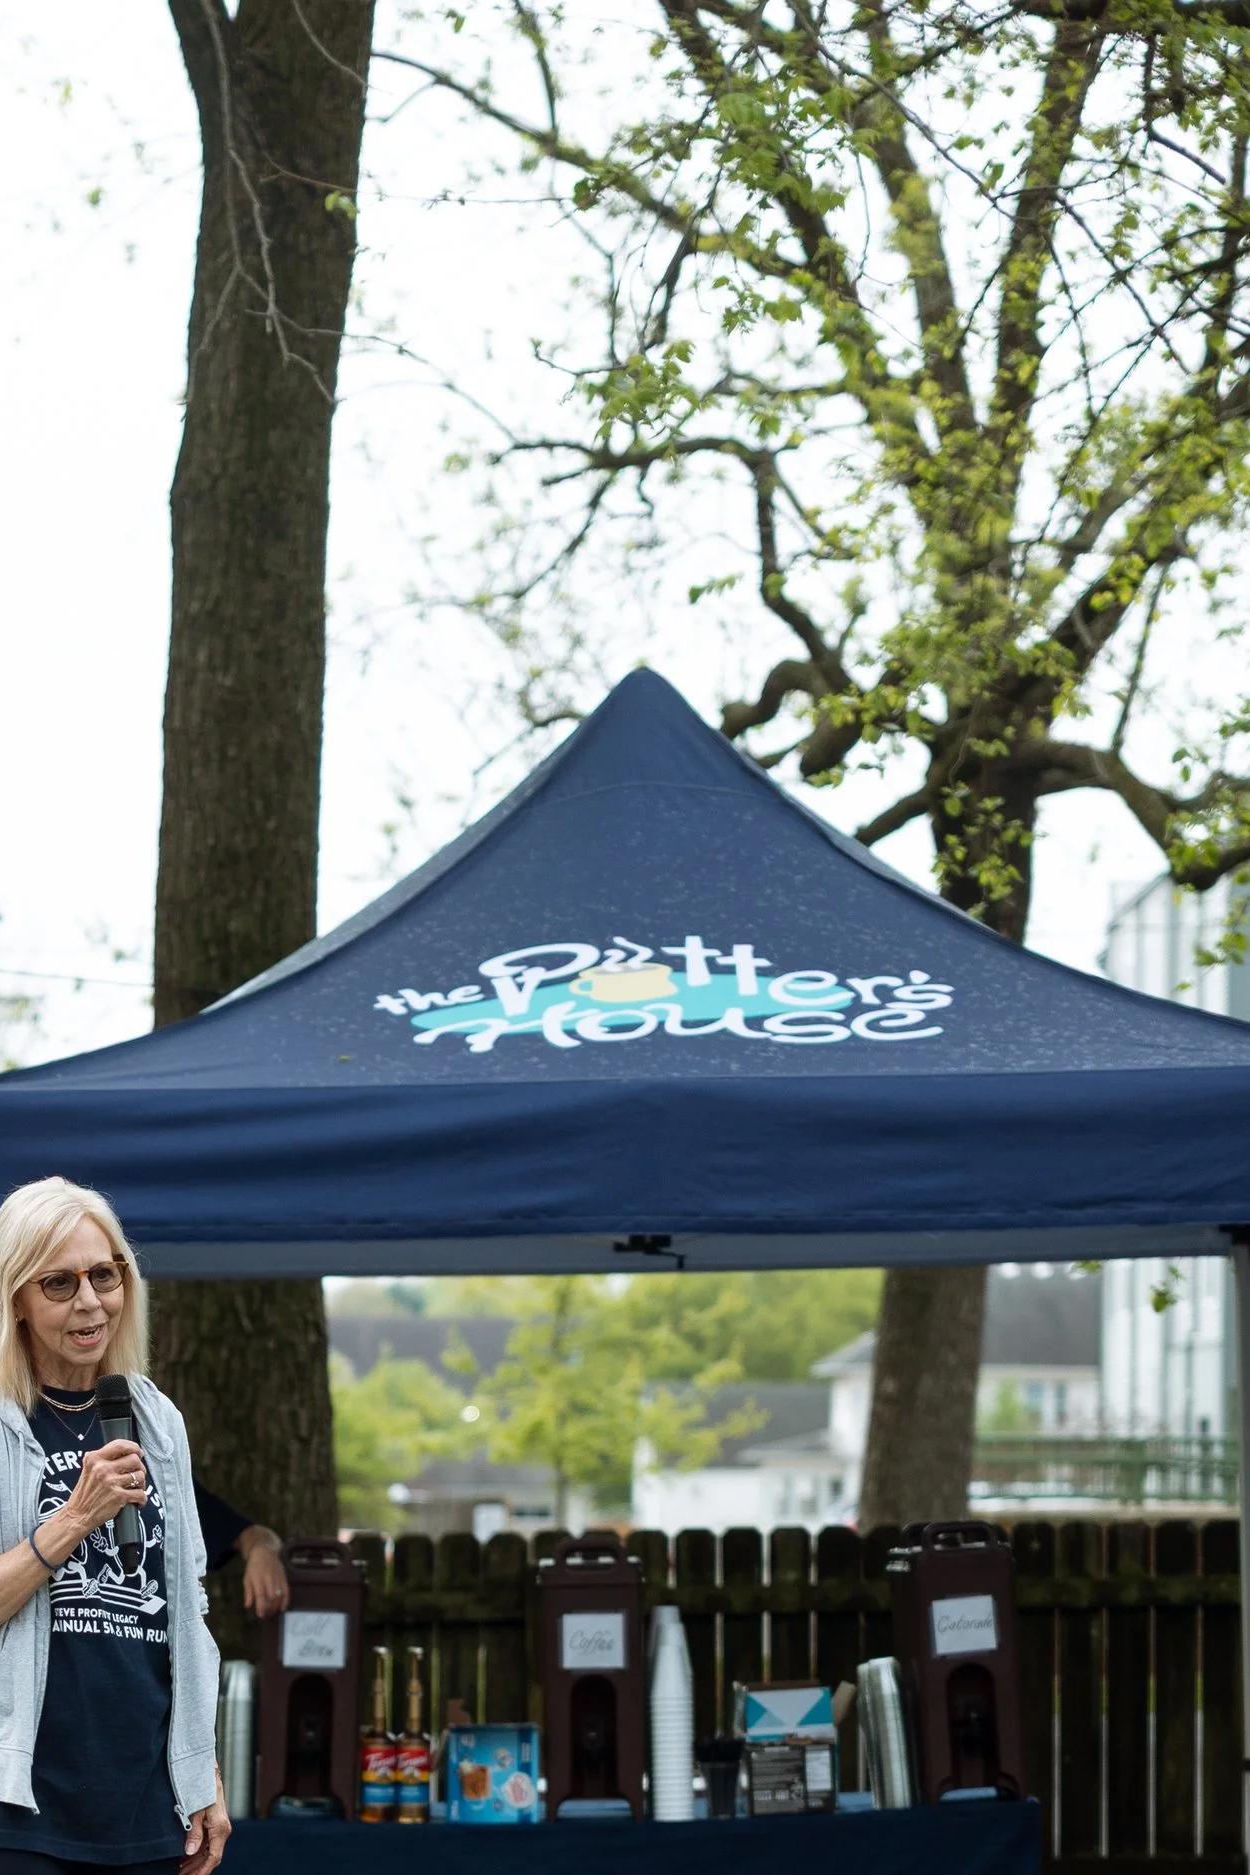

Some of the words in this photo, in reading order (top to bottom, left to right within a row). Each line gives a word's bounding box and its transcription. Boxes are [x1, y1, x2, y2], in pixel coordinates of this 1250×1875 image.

[373, 982, 484, 1016] the
[112, 1613, 139, 1624] LEGACY
[937, 1612, 992, 1633] Gatorade
[115, 1625, 123, 1637] &
[124, 1626, 144, 1640] FUN
